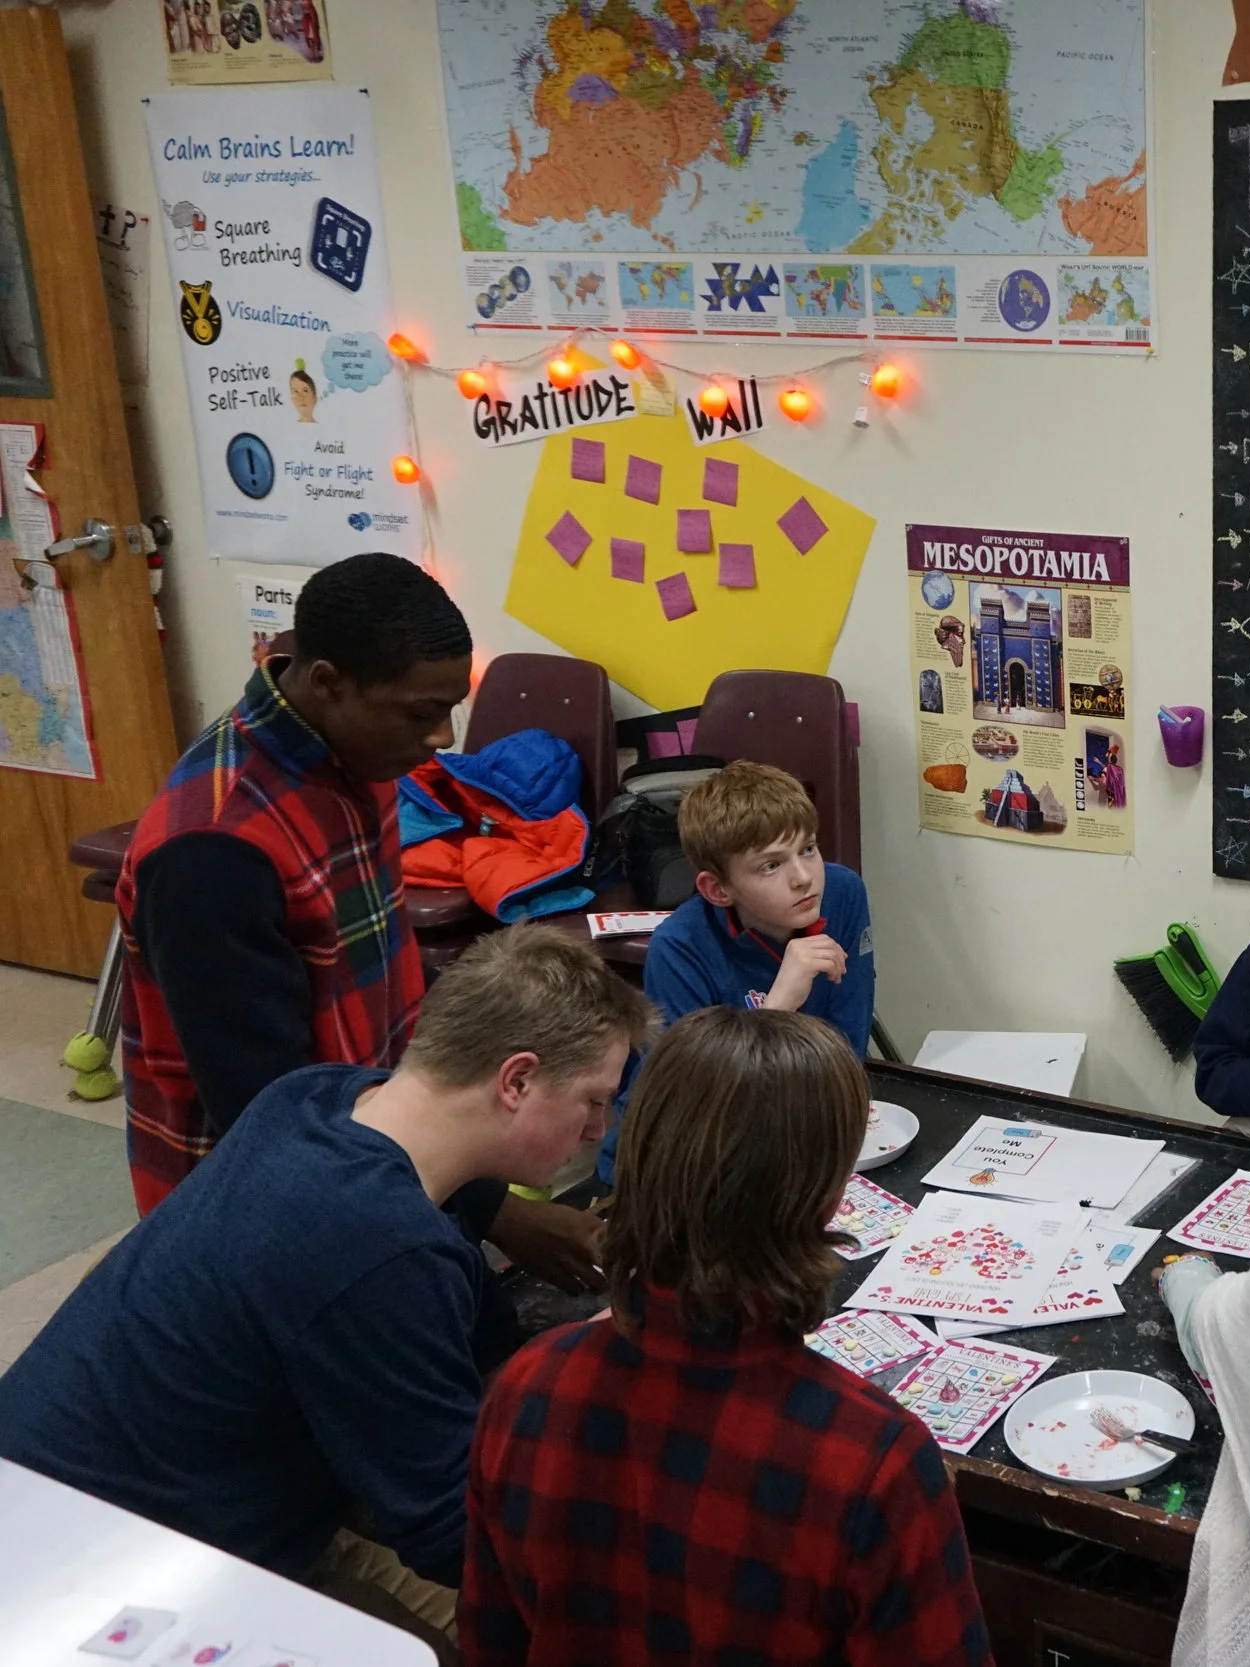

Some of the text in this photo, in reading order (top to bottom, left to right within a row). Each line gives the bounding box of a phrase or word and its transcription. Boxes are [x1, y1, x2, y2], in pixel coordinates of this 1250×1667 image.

[950, 119, 985, 132] CANADA
[163, 134, 355, 161] Calm Brains Learn!
[202, 170, 222, 184] Use
[224, 171, 252, 187] your
[214, 218, 271, 240] Square
[220, 245, 302, 267] Breathing
[227, 300, 332, 334] Visualization
[209, 363, 271, 385] Positive
[208, 390, 283, 412] Self-Talk
[314, 440, 345, 455] Avoid
[283, 461, 374, 483] Fight or Flight
[305, 484, 365, 501] Syndrome!
[982, 534, 1044, 547] GIFTS OF ANCIENT
[922, 540, 1111, 582] MESOPOTAMIA
[255, 585, 293, 606] Parts
[974, 1137, 1036, 1168] You Complete Me
[880, 1294, 983, 1314] VALENTINE'S
